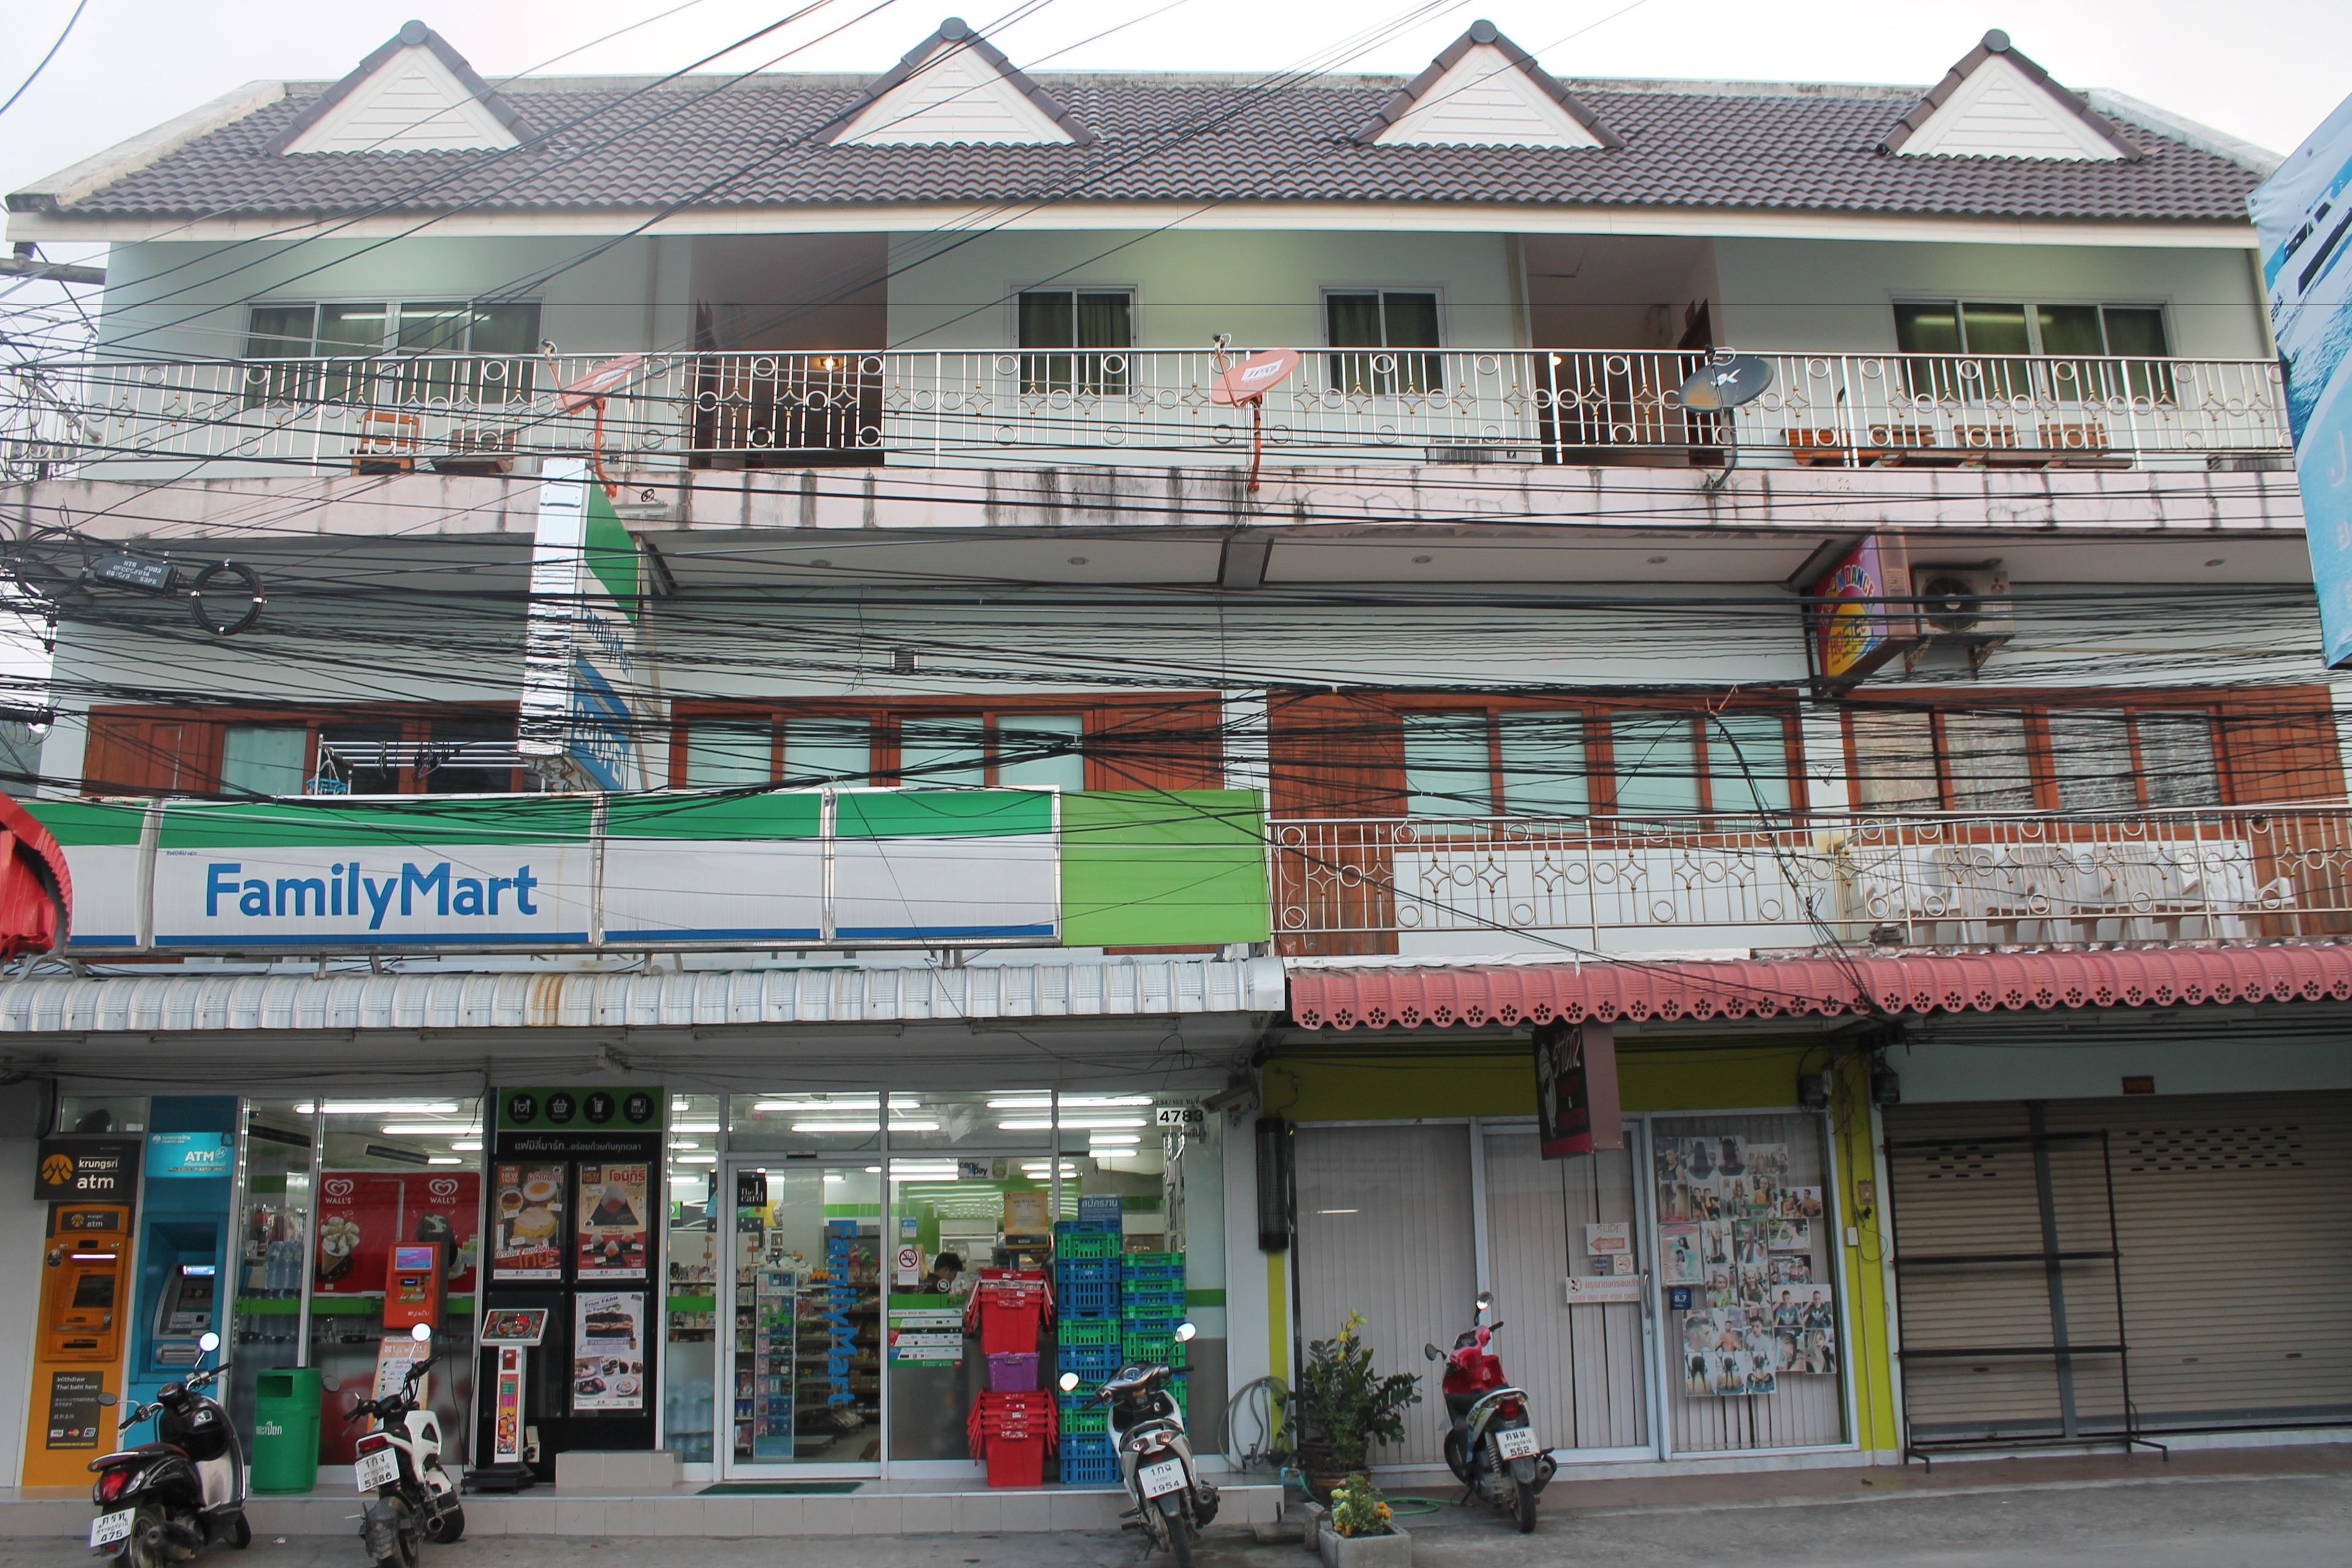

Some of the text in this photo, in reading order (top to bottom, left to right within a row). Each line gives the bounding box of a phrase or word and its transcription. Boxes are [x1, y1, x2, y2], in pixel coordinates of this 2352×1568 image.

[594, 723, 628, 790] OPEN
[206, 862, 538, 930] FamilyMart
[1159, 1109, 1204, 1123] 4783
[184, 1151, 214, 1161] ATM
[78, 1159, 118, 1169] krungsri
[77, 1174, 115, 1189] atm
[741, 1191, 763, 1202] card
[1597, 1224, 1623, 1233] SLIDE
[760, 1303, 791, 1328] 24
[823, 1220, 858, 1406] FamilyMart
[1510, 1446, 1530, 1456] 552
[364, 1472, 392, 1488] 5386
[1152, 1480, 1180, 1493] 1954
[100, 1529, 123, 1542] 475
